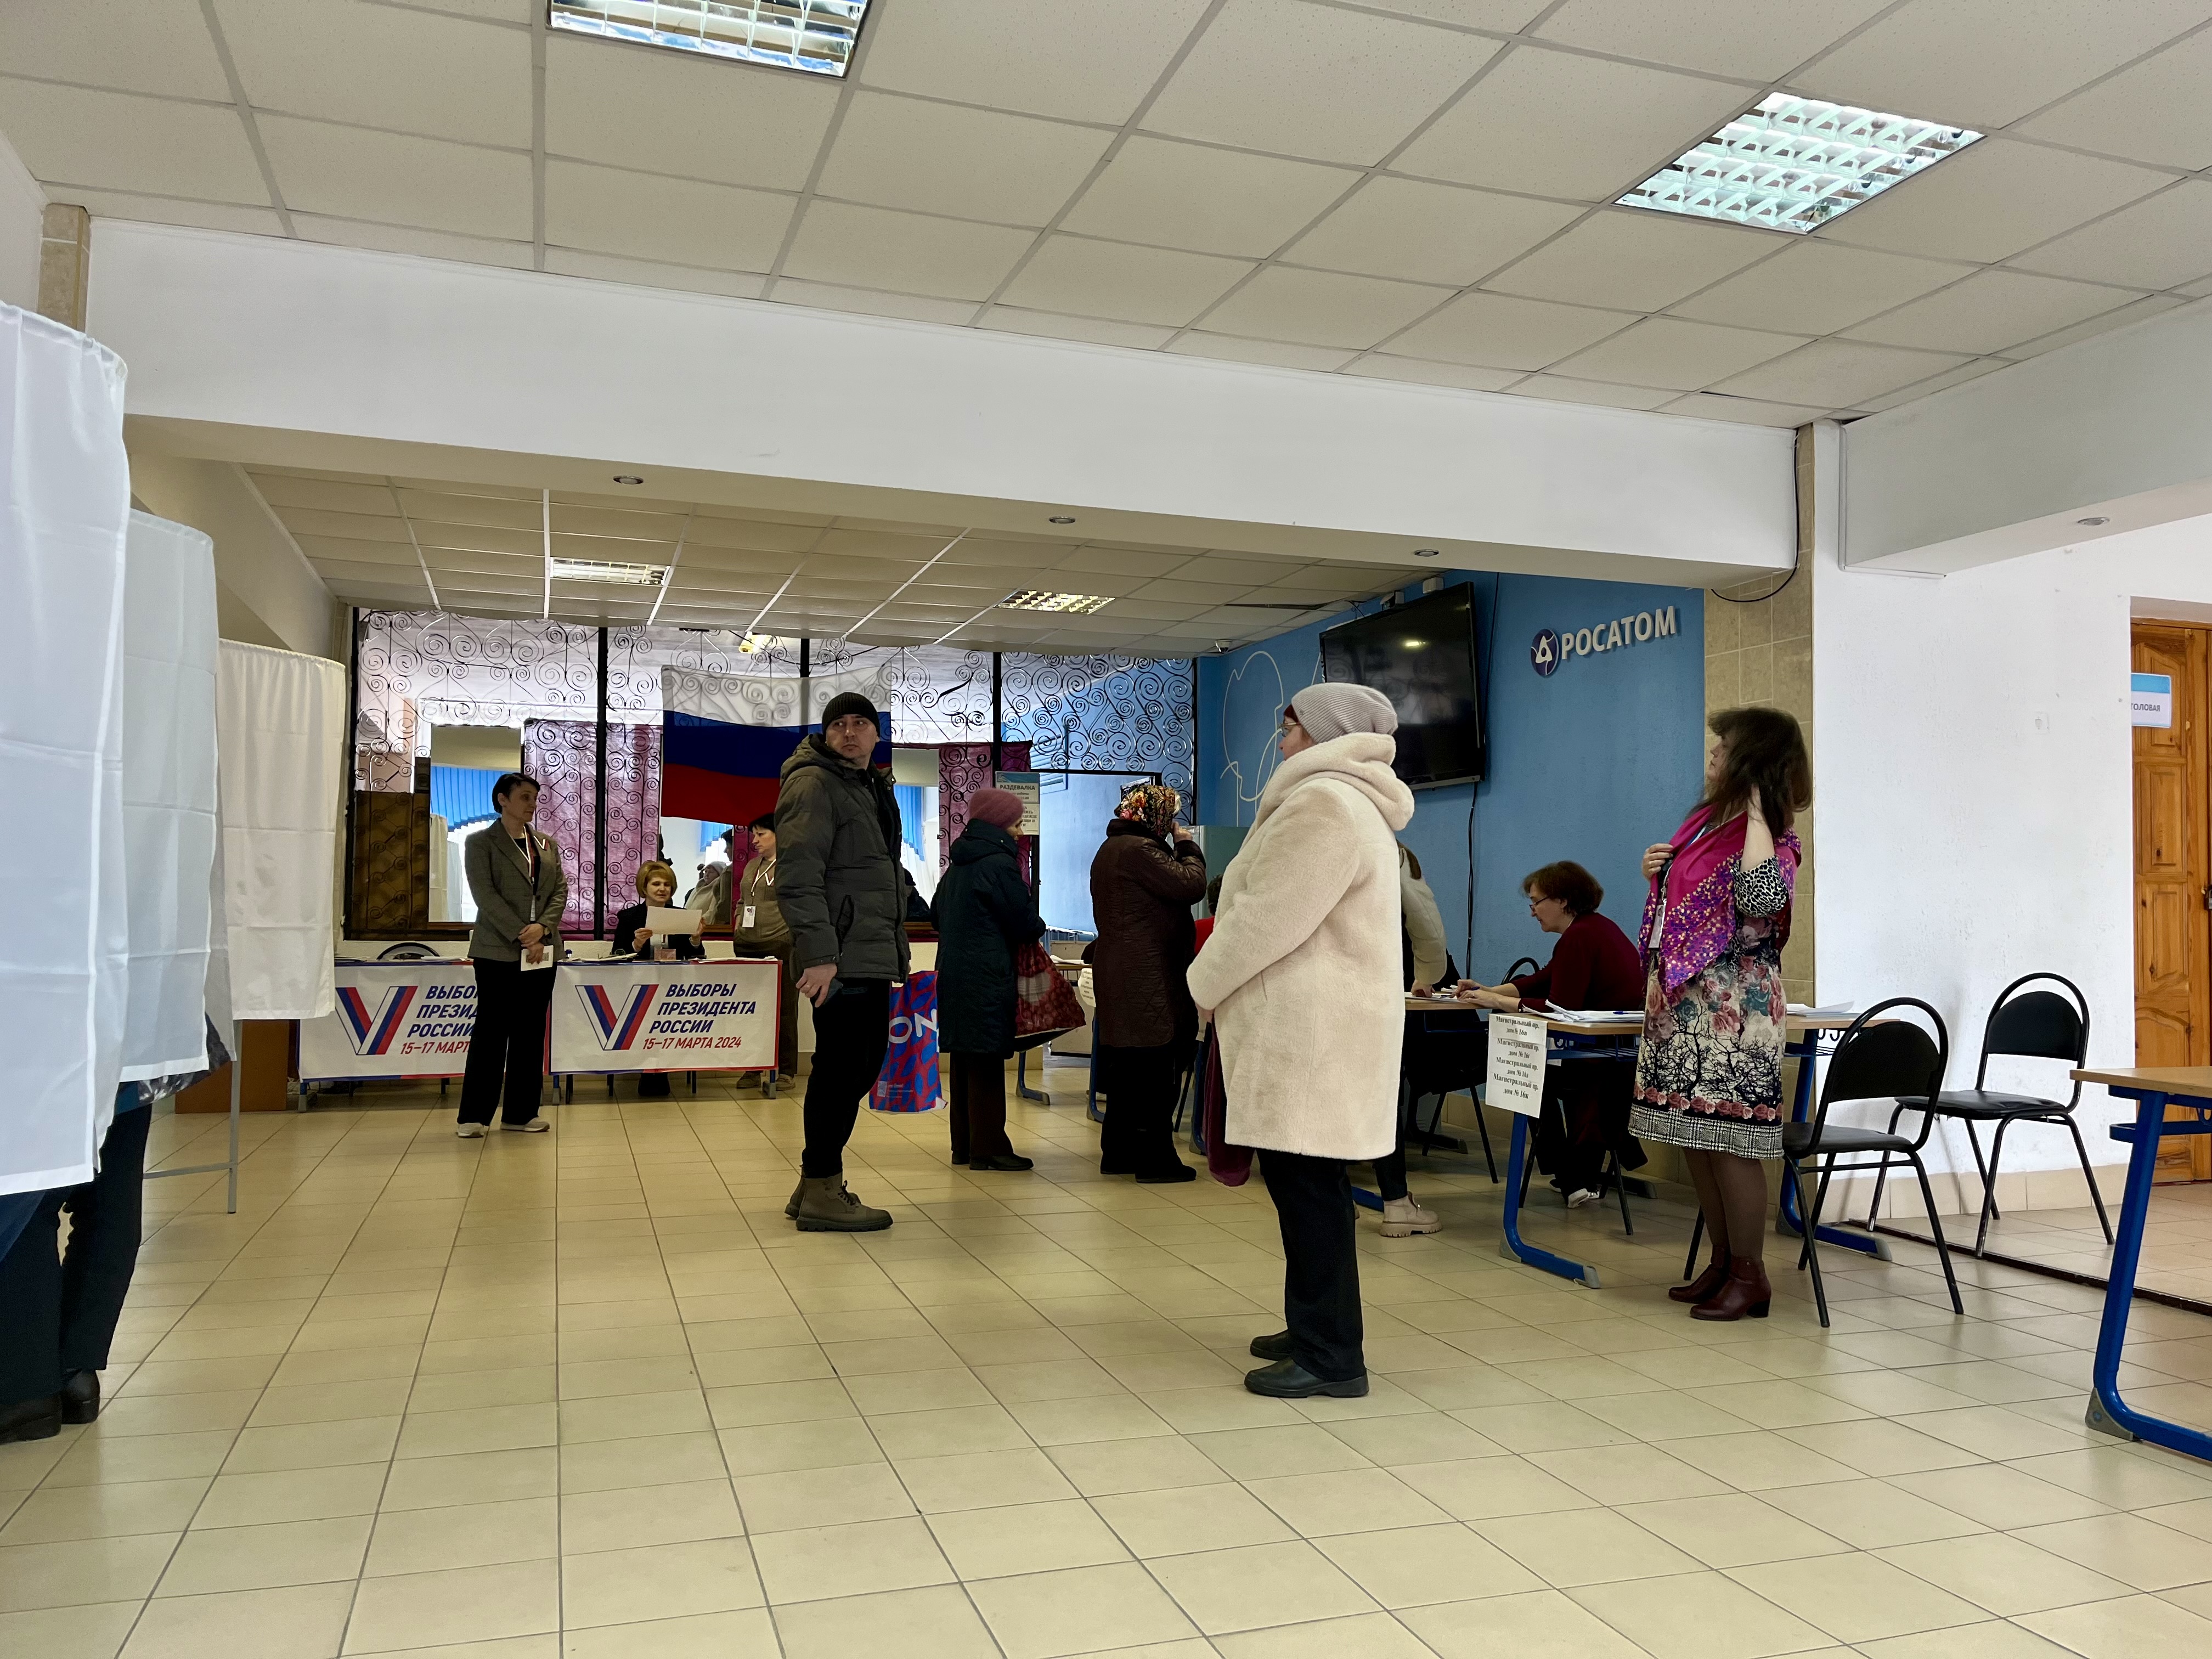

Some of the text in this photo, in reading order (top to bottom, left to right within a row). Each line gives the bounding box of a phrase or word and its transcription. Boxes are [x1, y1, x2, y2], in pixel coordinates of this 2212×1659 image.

[1561, 605, 1676, 660] РОСАТОМ
[2131, 703, 2160, 712] ТОЛОВАЯ
[425, 985, 478, 1000] ВЫБО
[665, 984, 737, 997] ВЫБОРЫ
[416, 1004, 478, 1020] ПРЕЗИД
[657, 1001, 757, 1017] ПРЕЗИДЕНТА
[648, 1019, 714, 1034] РОССИИ
[1496, 1016, 1531, 1027] Магистральный
[434, 1041, 471, 1054] МАРТ
[674, 1037, 714, 1049] МАРТА
[714, 1036, 742, 1048] 2024
